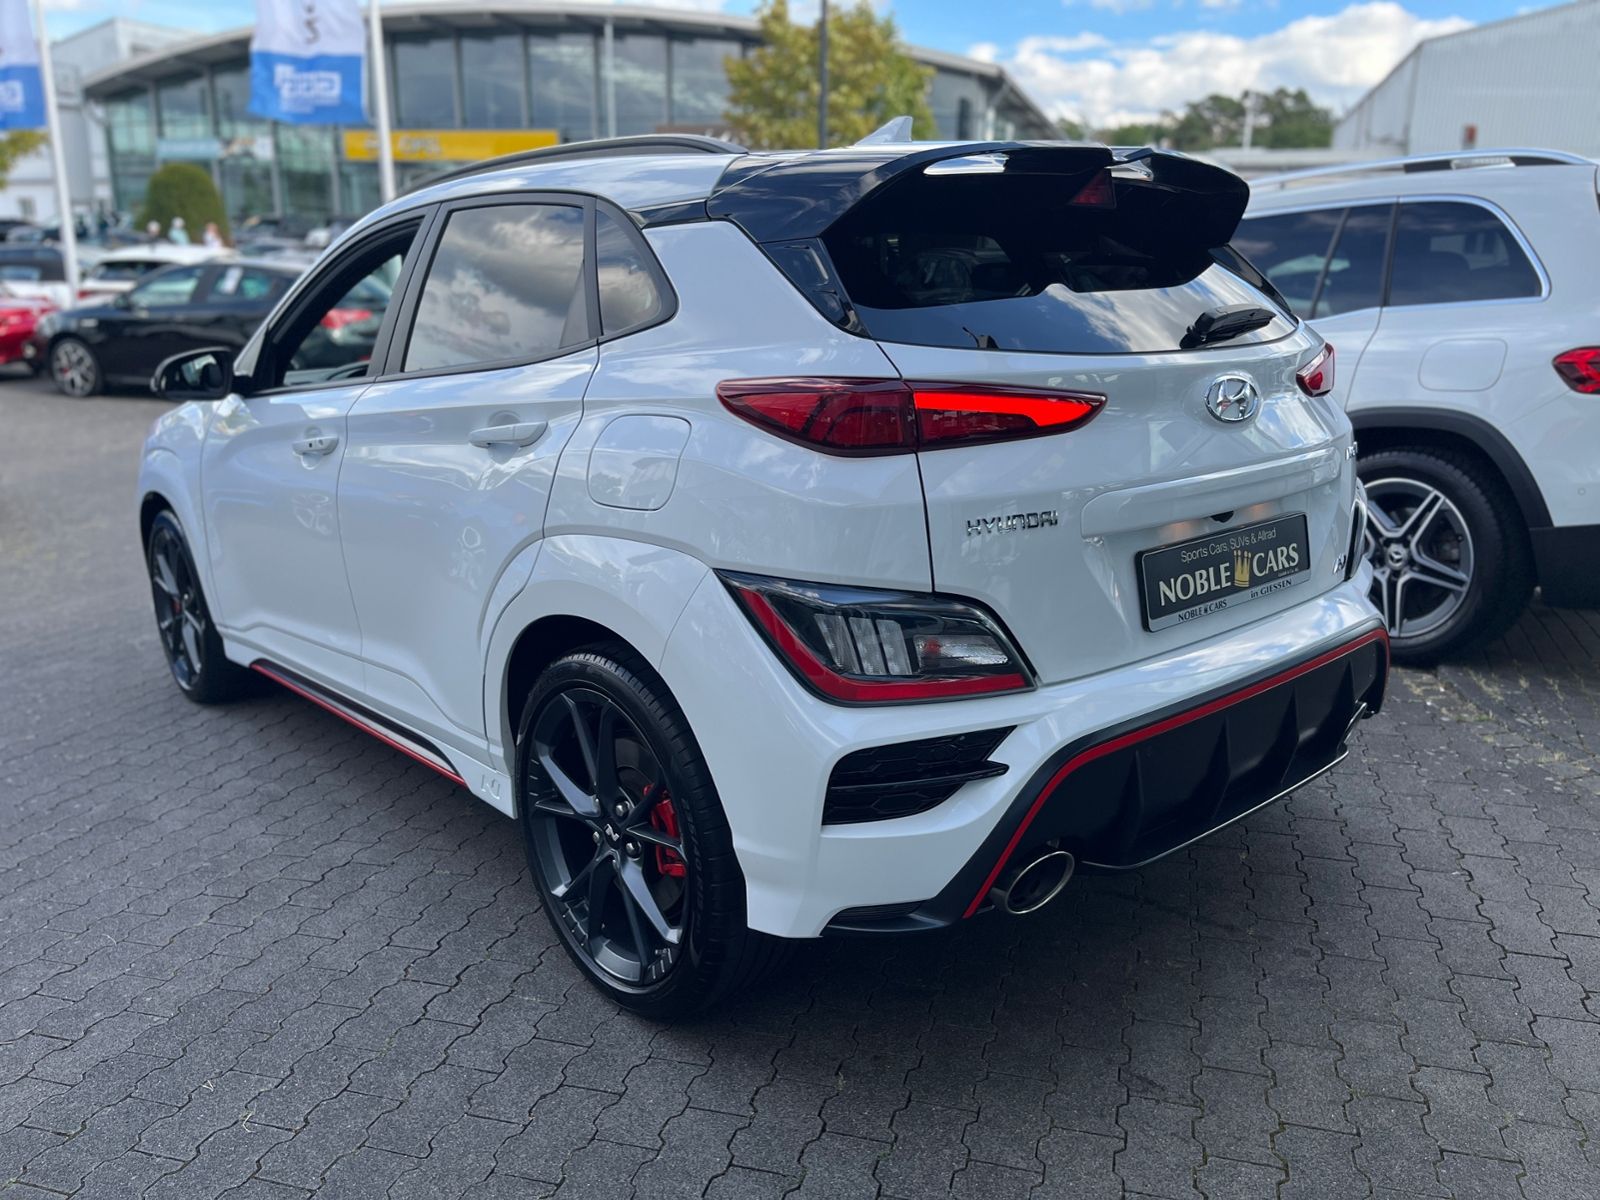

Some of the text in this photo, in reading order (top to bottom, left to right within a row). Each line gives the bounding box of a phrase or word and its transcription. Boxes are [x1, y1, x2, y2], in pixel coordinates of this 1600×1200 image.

[966, 510, 1059, 537] HYUNDAI
[1181, 548, 1208, 564] Sports
[1229, 535, 1250, 550] SUVs
[1250, 532, 1257, 543] &
[1257, 527, 1277, 542] Allrad
[1159, 543, 1300, 607] NOBLE CARS
[1250, 579, 1292, 599] in GIESSEN
[1178, 599, 1228, 622] NOBLE CARS
